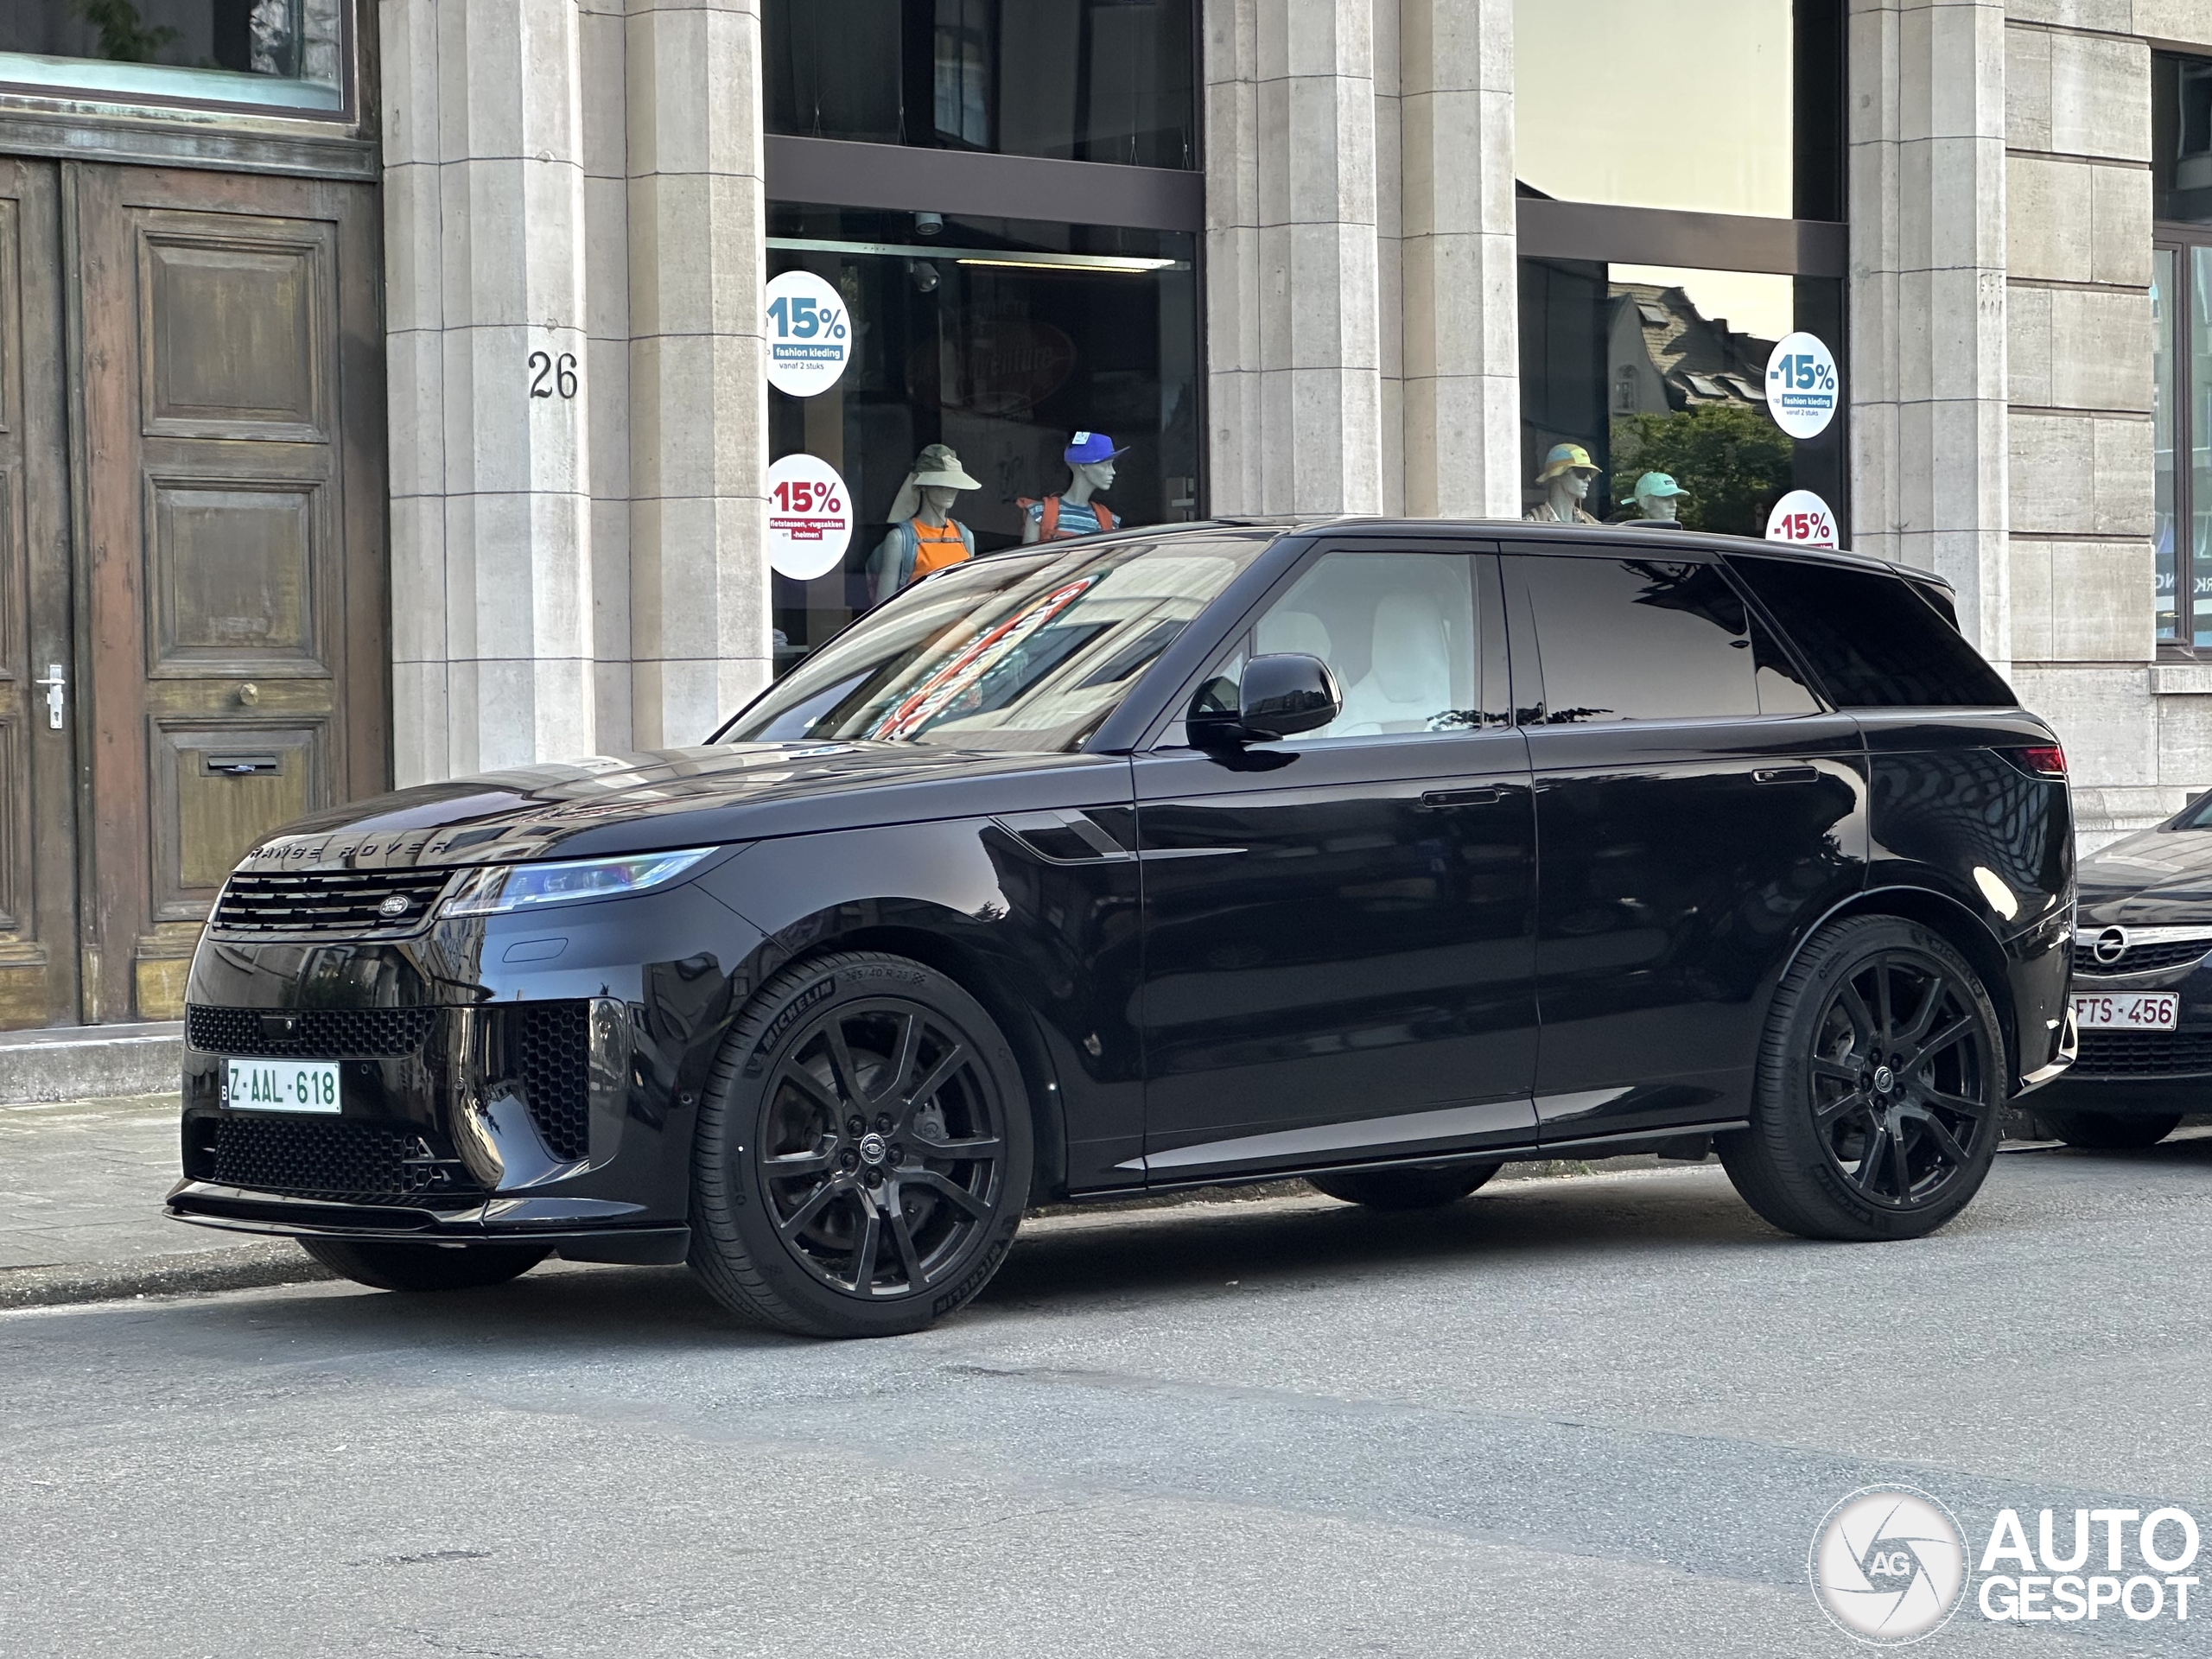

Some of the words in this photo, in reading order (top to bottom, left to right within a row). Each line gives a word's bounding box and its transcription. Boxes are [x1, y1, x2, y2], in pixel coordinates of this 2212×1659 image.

[766, 297, 846, 339] 15%
[776, 347, 808, 357] fashion
[809, 347, 841, 359] kleding
[528, 351, 577, 399] 26
[1770, 354, 1834, 391] -15%
[1783, 397, 1807, 405] fashion
[1808, 397, 1831, 407] kleding
[1774, 512, 1830, 539] -15%
[249, 847, 324, 860] RANGE
[338, 841, 451, 859] ROVER
[762, 981, 833, 1052] MICHELIN
[221, 1085, 228, 1101] B
[230, 1068, 334, 1105] Z-AAL-618
